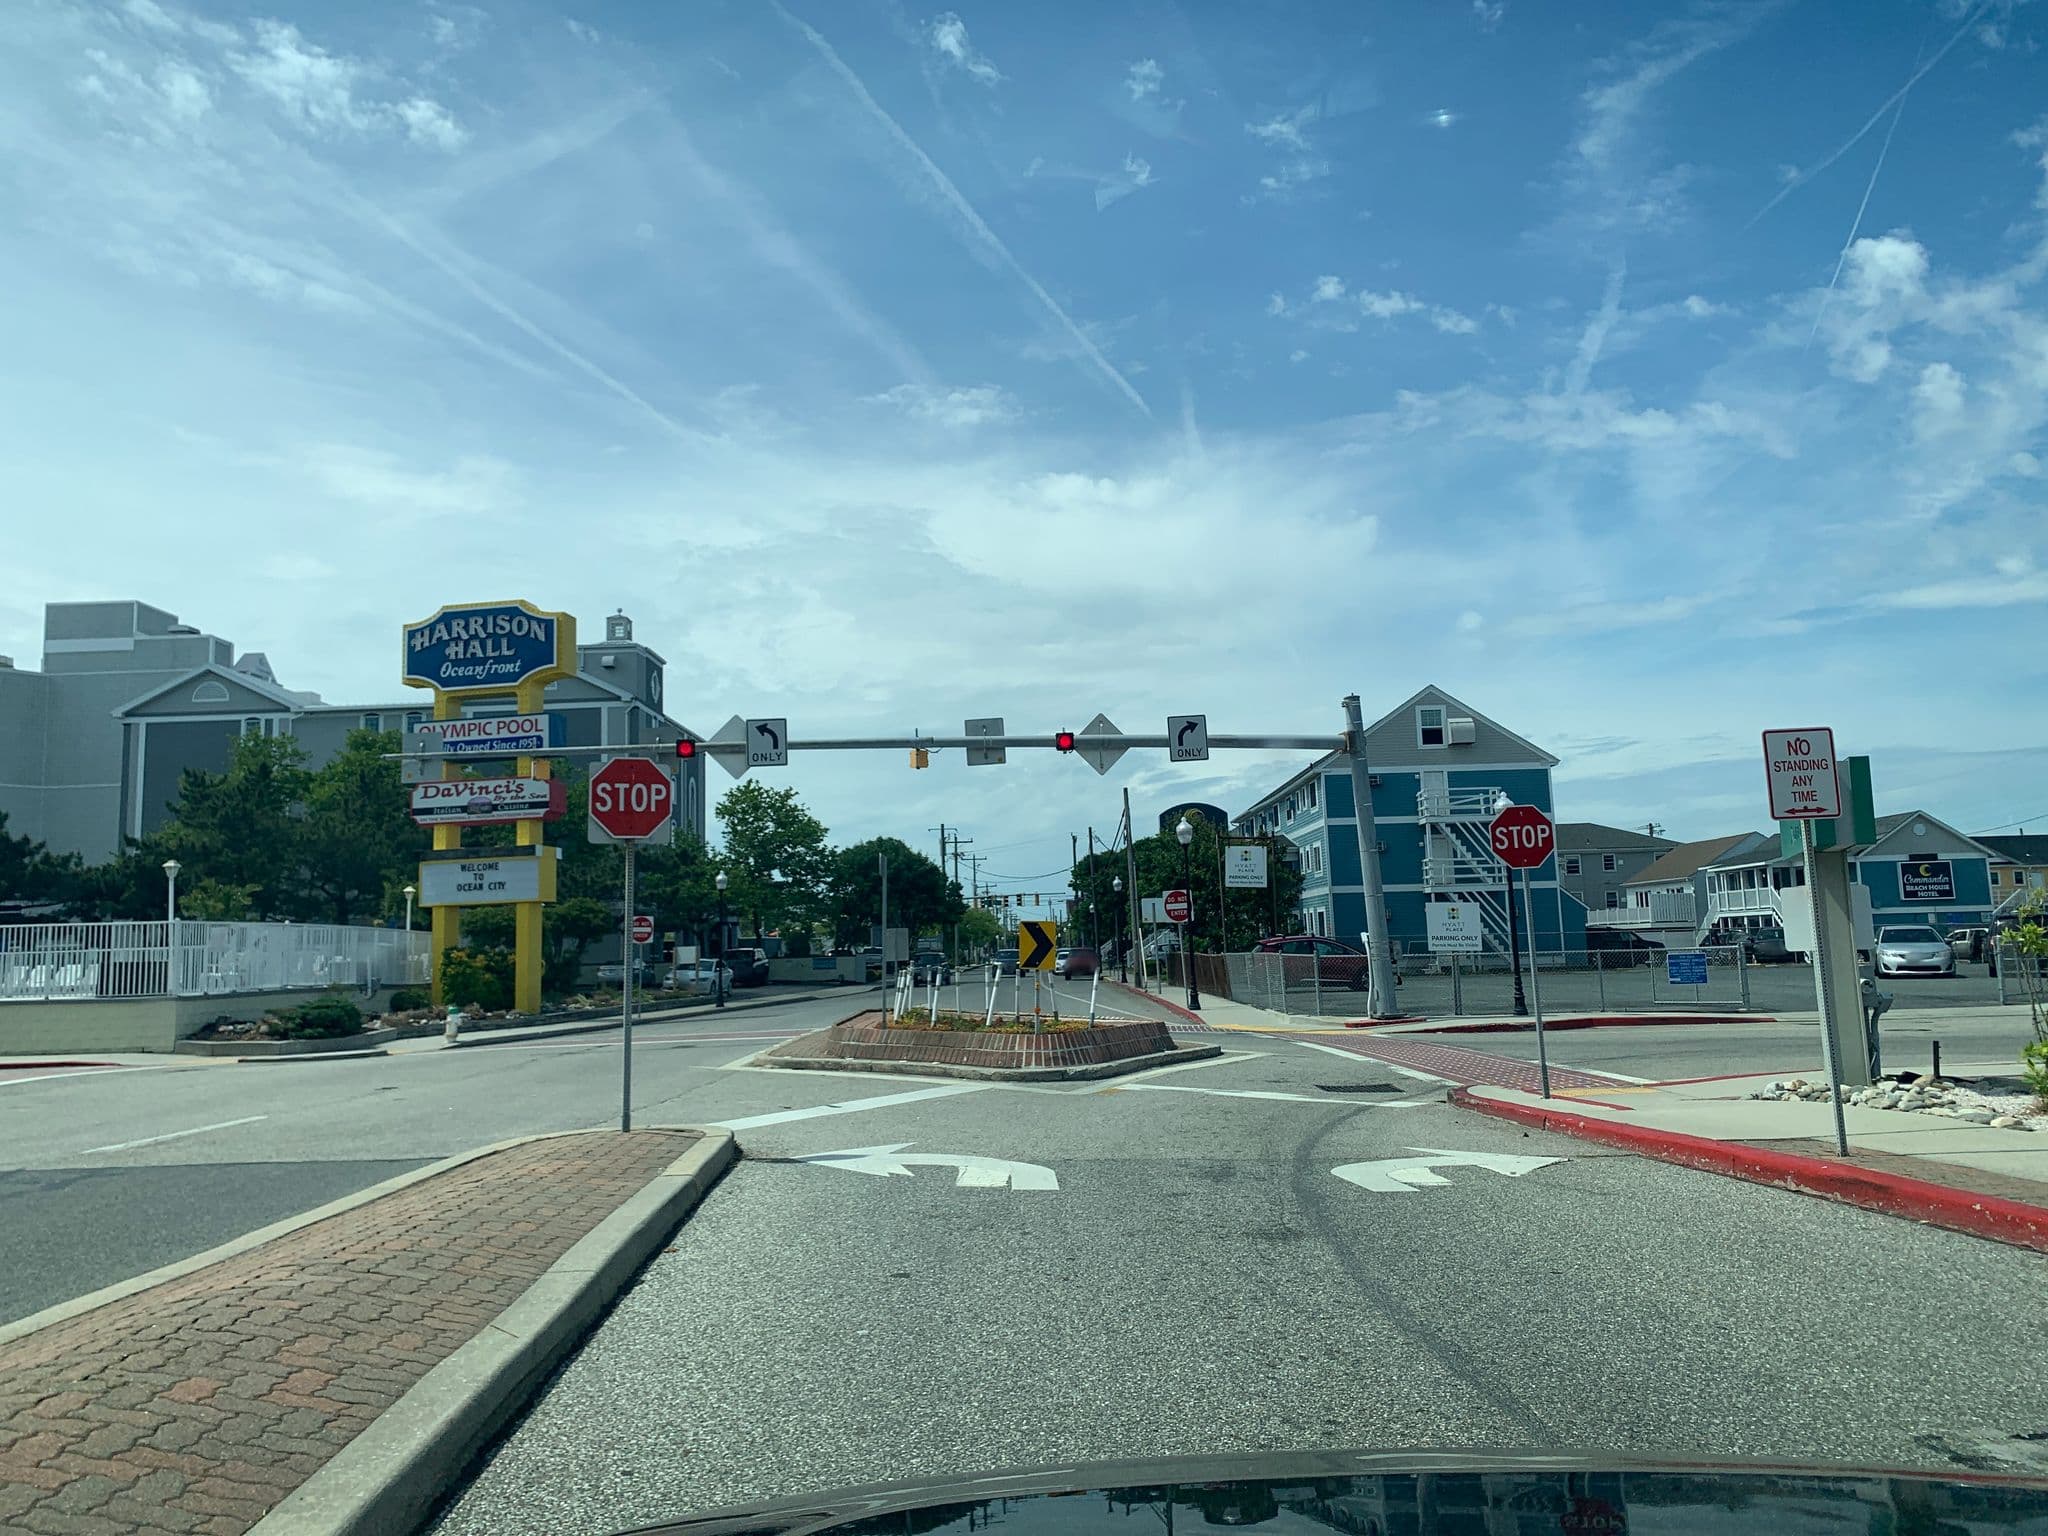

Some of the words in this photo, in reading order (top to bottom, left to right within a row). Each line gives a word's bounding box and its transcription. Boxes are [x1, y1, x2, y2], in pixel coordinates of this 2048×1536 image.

[411, 615, 546, 652] HARRISON
[445, 638, 516, 659] HALL
[440, 659, 521, 680] Oceanfront
[497, 718, 544, 735] POOL
[457, 741, 490, 752] Owned
[492, 739, 517, 750] Since
[1787, 739, 1811, 756] NO
[752, 752, 782, 762] ONLY
[1178, 748, 1202, 758] ONLY
[1774, 758, 1829, 773] STANDING
[1792, 775, 1814, 787] ANY
[420, 781, 525, 799] DaVinci's
[1791, 790, 1818, 803] TIME
[596, 782, 667, 812] STOP
[433, 807, 463, 815] Italian
[1495, 824, 1550, 850] STOP
[460, 862, 500, 872] WELCOME
[473, 873, 484, 881] TO
[1903, 873, 1950, 884] Commander
[456, 883, 484, 892] OCEAN
[488, 881, 506, 891] CITY
